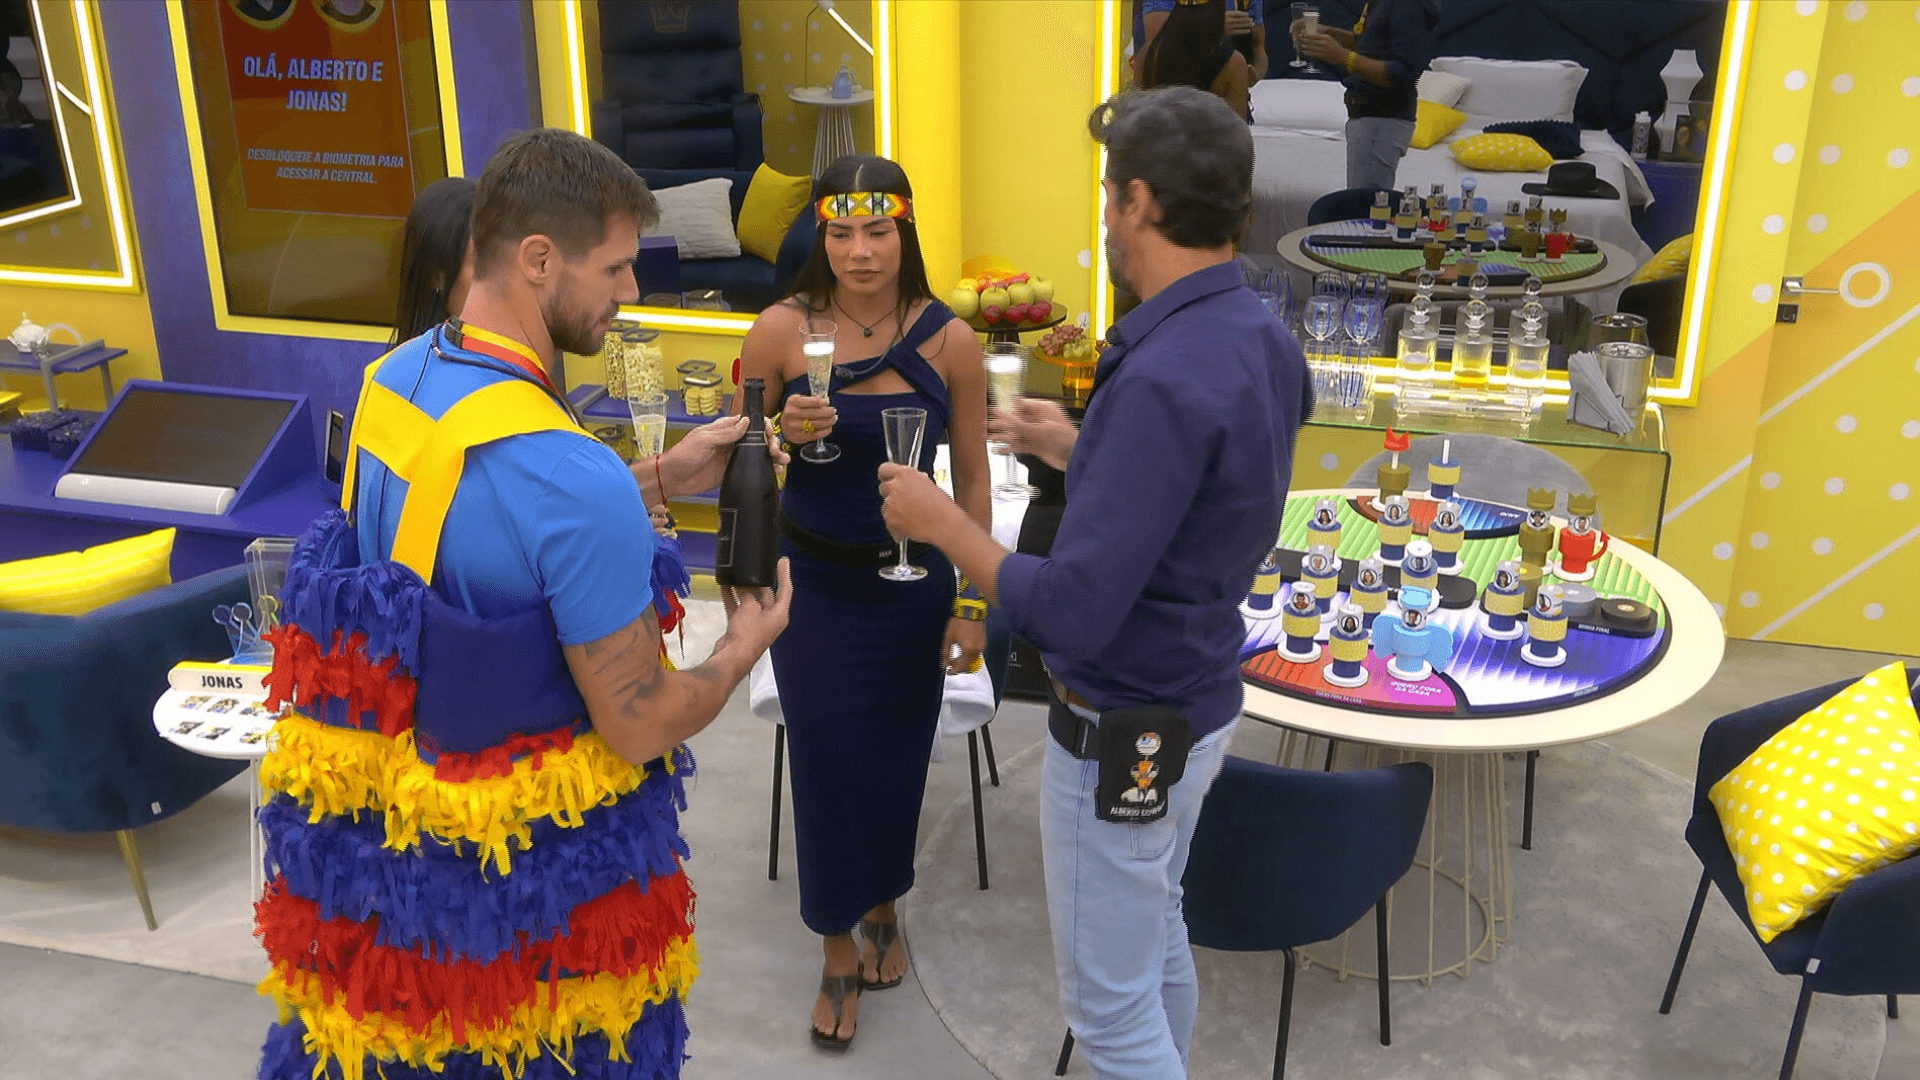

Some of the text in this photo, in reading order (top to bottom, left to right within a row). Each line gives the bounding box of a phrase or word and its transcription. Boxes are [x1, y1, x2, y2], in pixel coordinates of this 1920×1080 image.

[243, 52, 384, 82] OLÁ, ALBERTO E
[286, 89, 348, 112] JONAS!
[247, 148, 404, 168] DESBLOQUEIE A BIOMETRIA PARA
[276, 166, 378, 184] ACESSAR A CENTRAL.
[202, 675, 243, 689] JONAS
